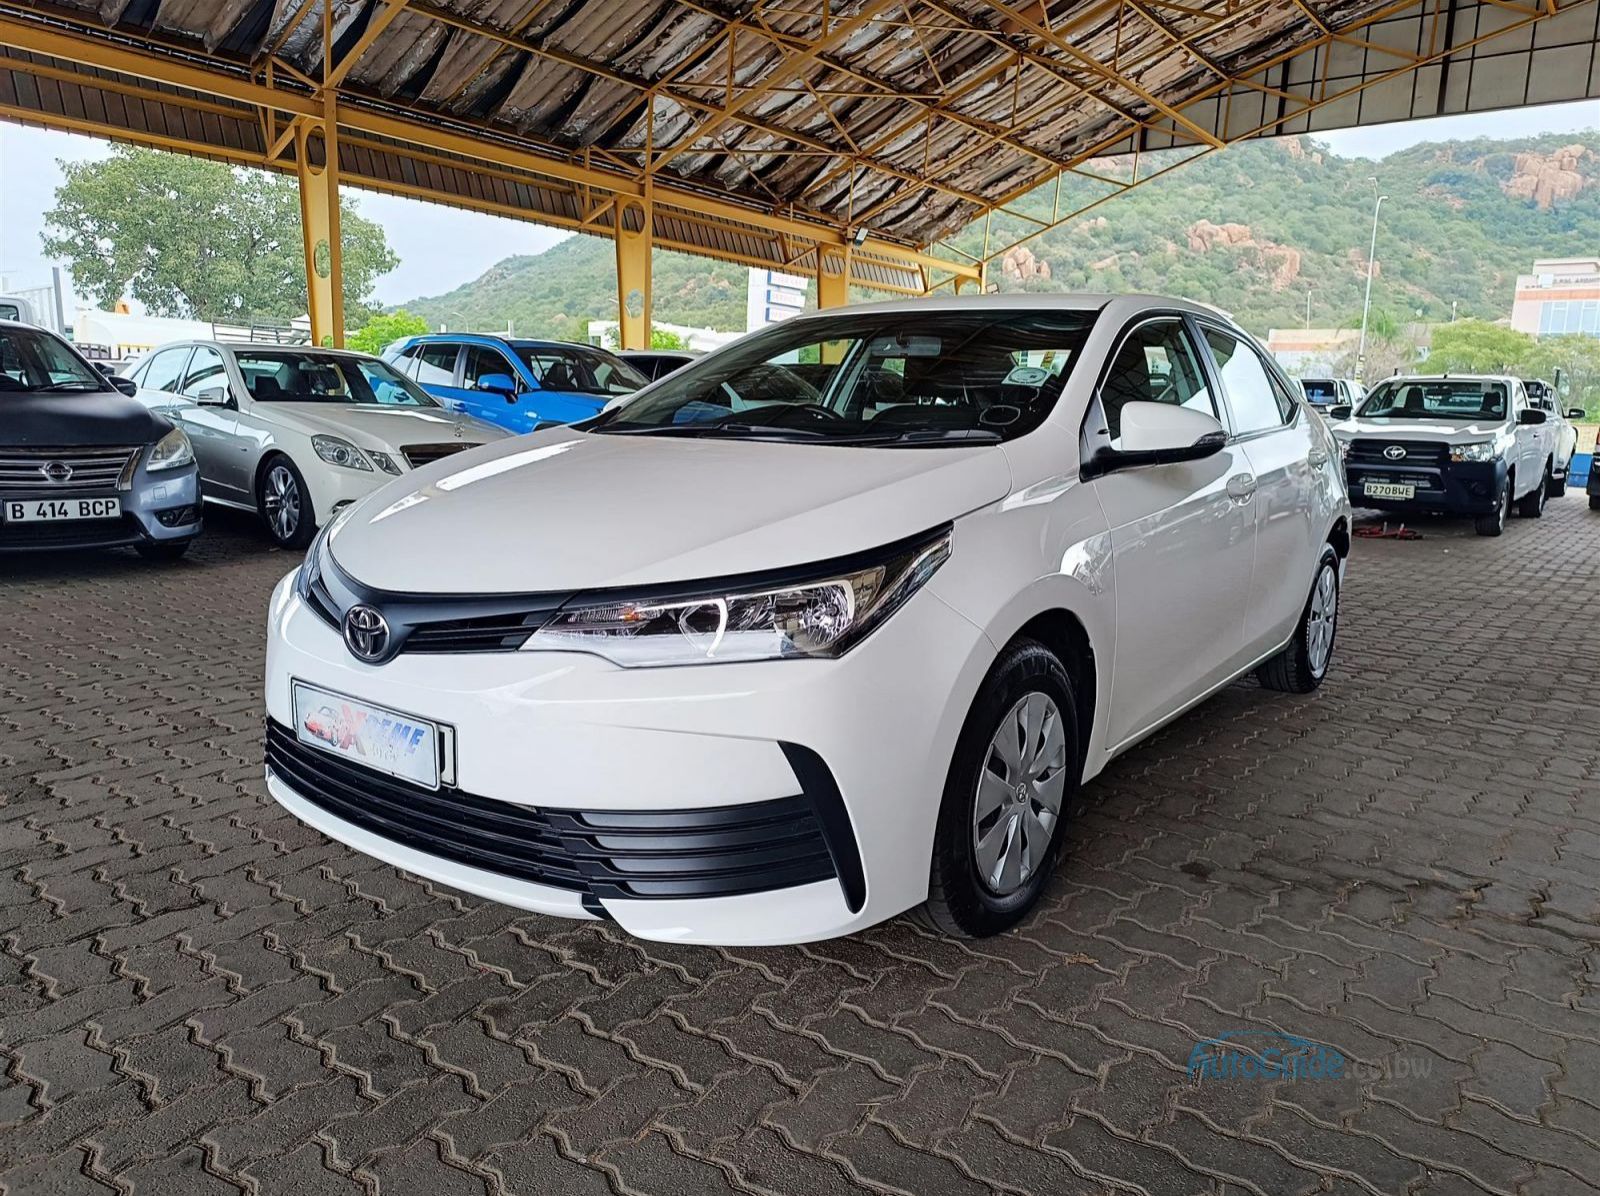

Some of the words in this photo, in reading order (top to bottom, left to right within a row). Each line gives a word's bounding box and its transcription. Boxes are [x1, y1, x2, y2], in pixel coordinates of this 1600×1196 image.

[1366, 484, 1412, 496] B270BWE
[11, 503, 25, 519] B
[36, 502, 69, 518] 414
[78, 500, 116, 517] BCP
